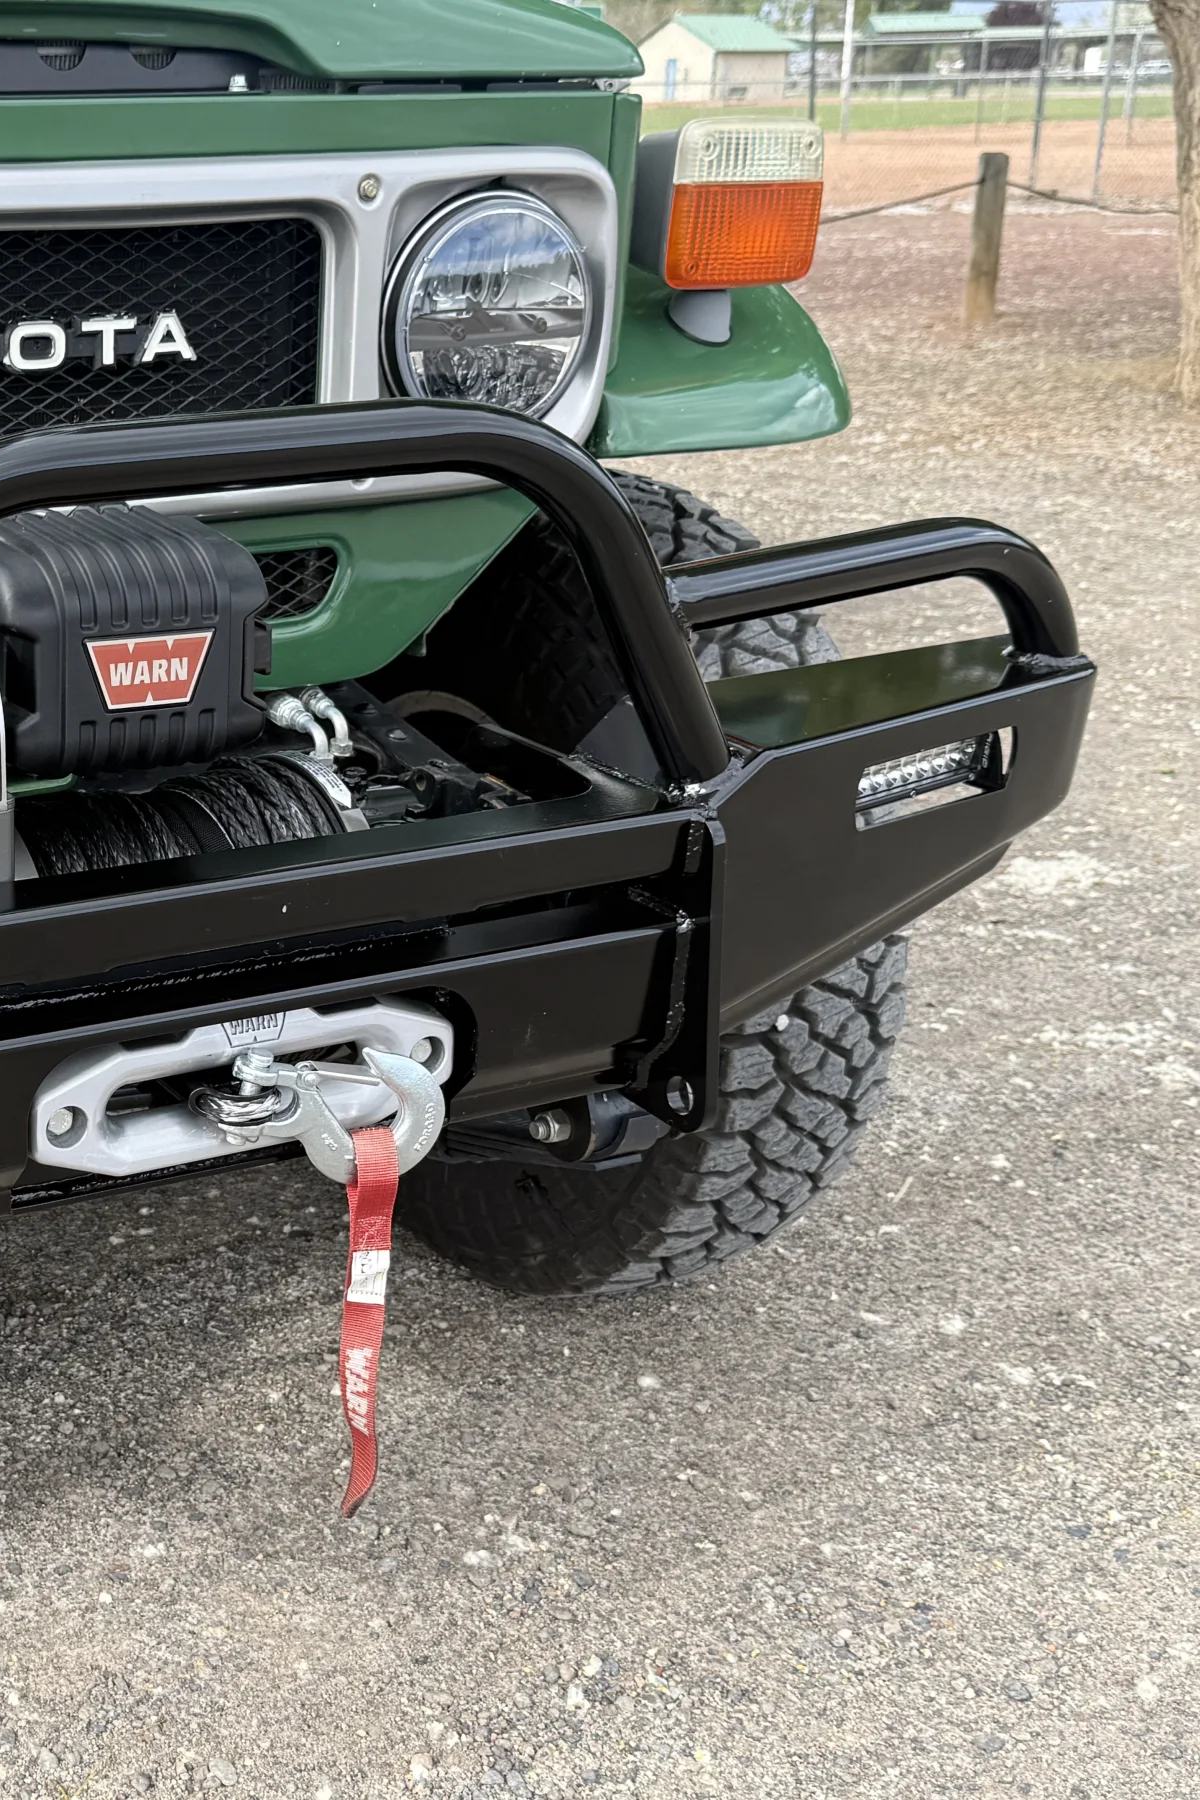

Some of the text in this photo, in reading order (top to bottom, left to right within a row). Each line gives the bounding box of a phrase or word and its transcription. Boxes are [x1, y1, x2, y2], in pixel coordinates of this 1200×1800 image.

[109, 657, 188, 687] WARN
[229, 1013, 279, 1035] WARN
[344, 1348, 373, 1437] WARN
